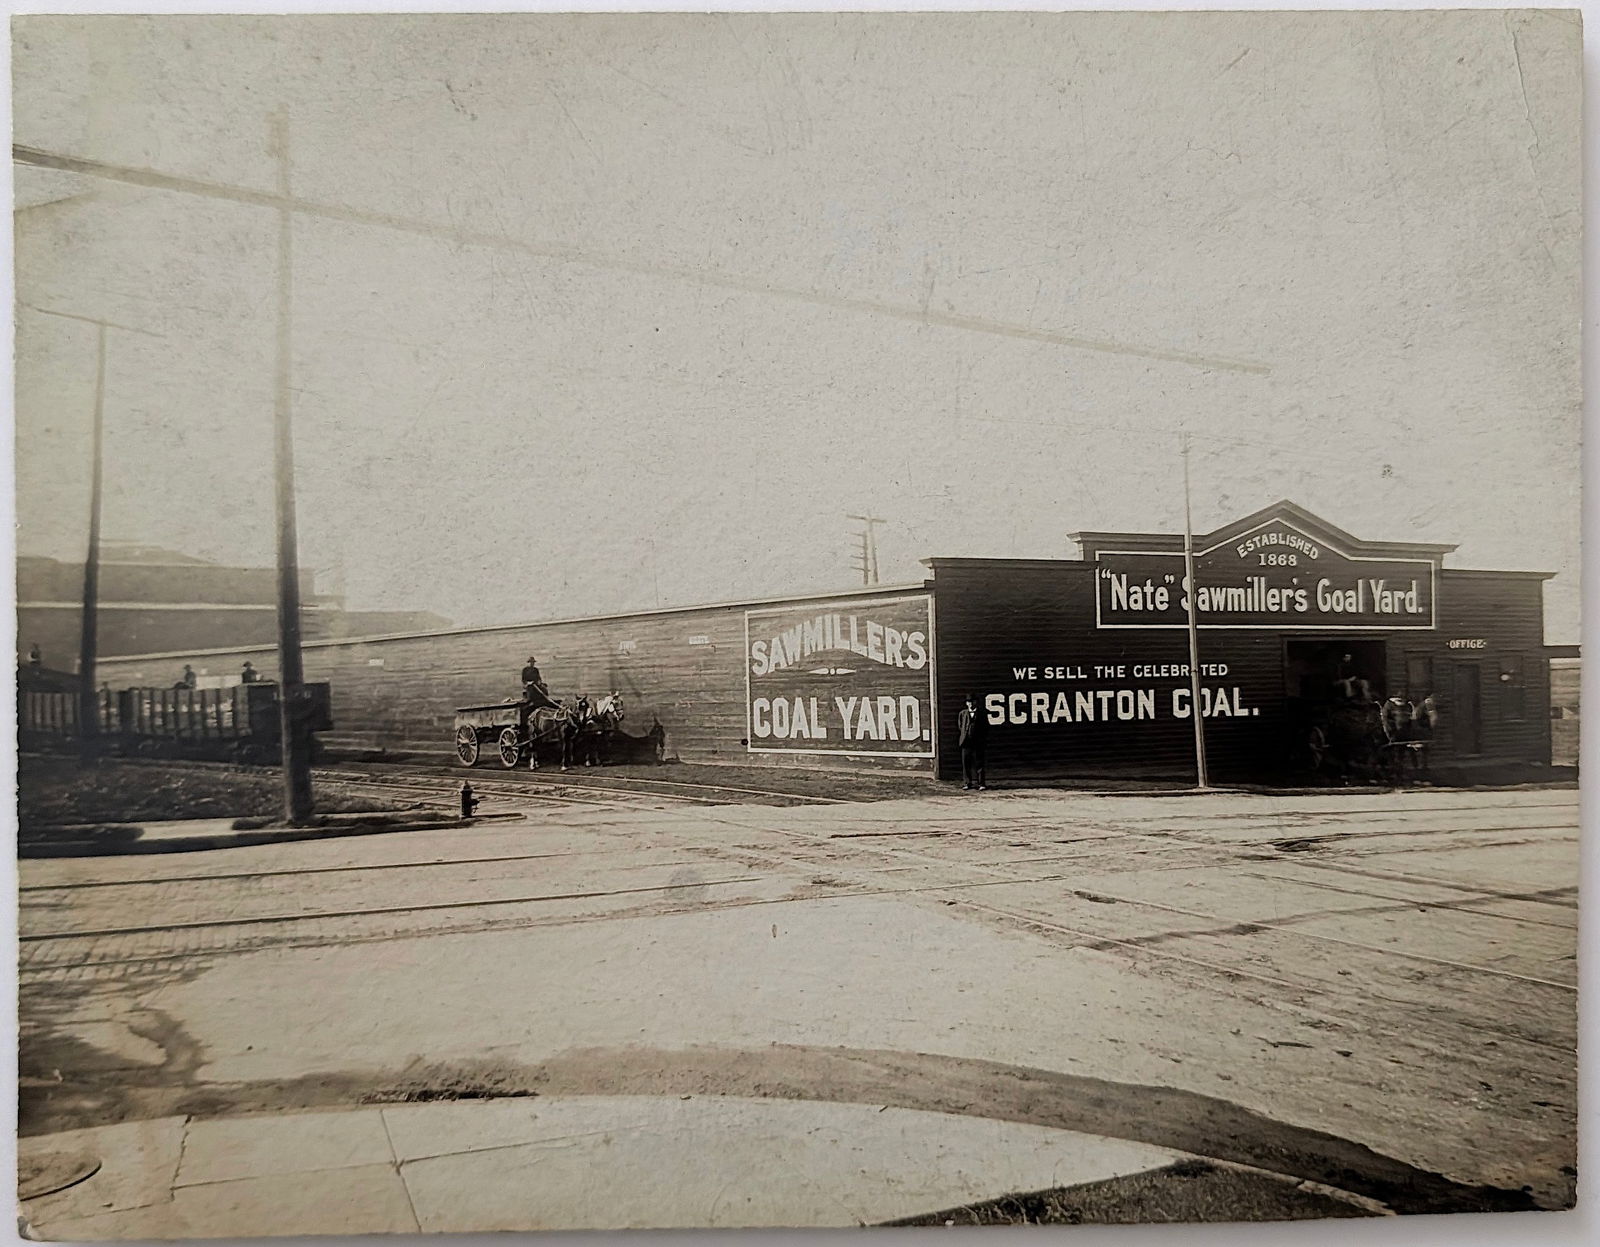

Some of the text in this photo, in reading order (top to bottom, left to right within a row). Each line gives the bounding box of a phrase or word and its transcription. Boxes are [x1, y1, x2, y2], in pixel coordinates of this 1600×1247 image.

[1235, 532, 1319, 560] ESTABLISHED
[1258, 552, 1298, 567] 1868
[1369, 579, 1423, 613] Yard.
[751, 614, 927, 676] SAWMILLER'S
[1013, 663, 1228, 680] WE SELL THE CELEBRTED
[753, 695, 930, 741] COAL YARD.
[985, 689, 1155, 726] SCRANTON
